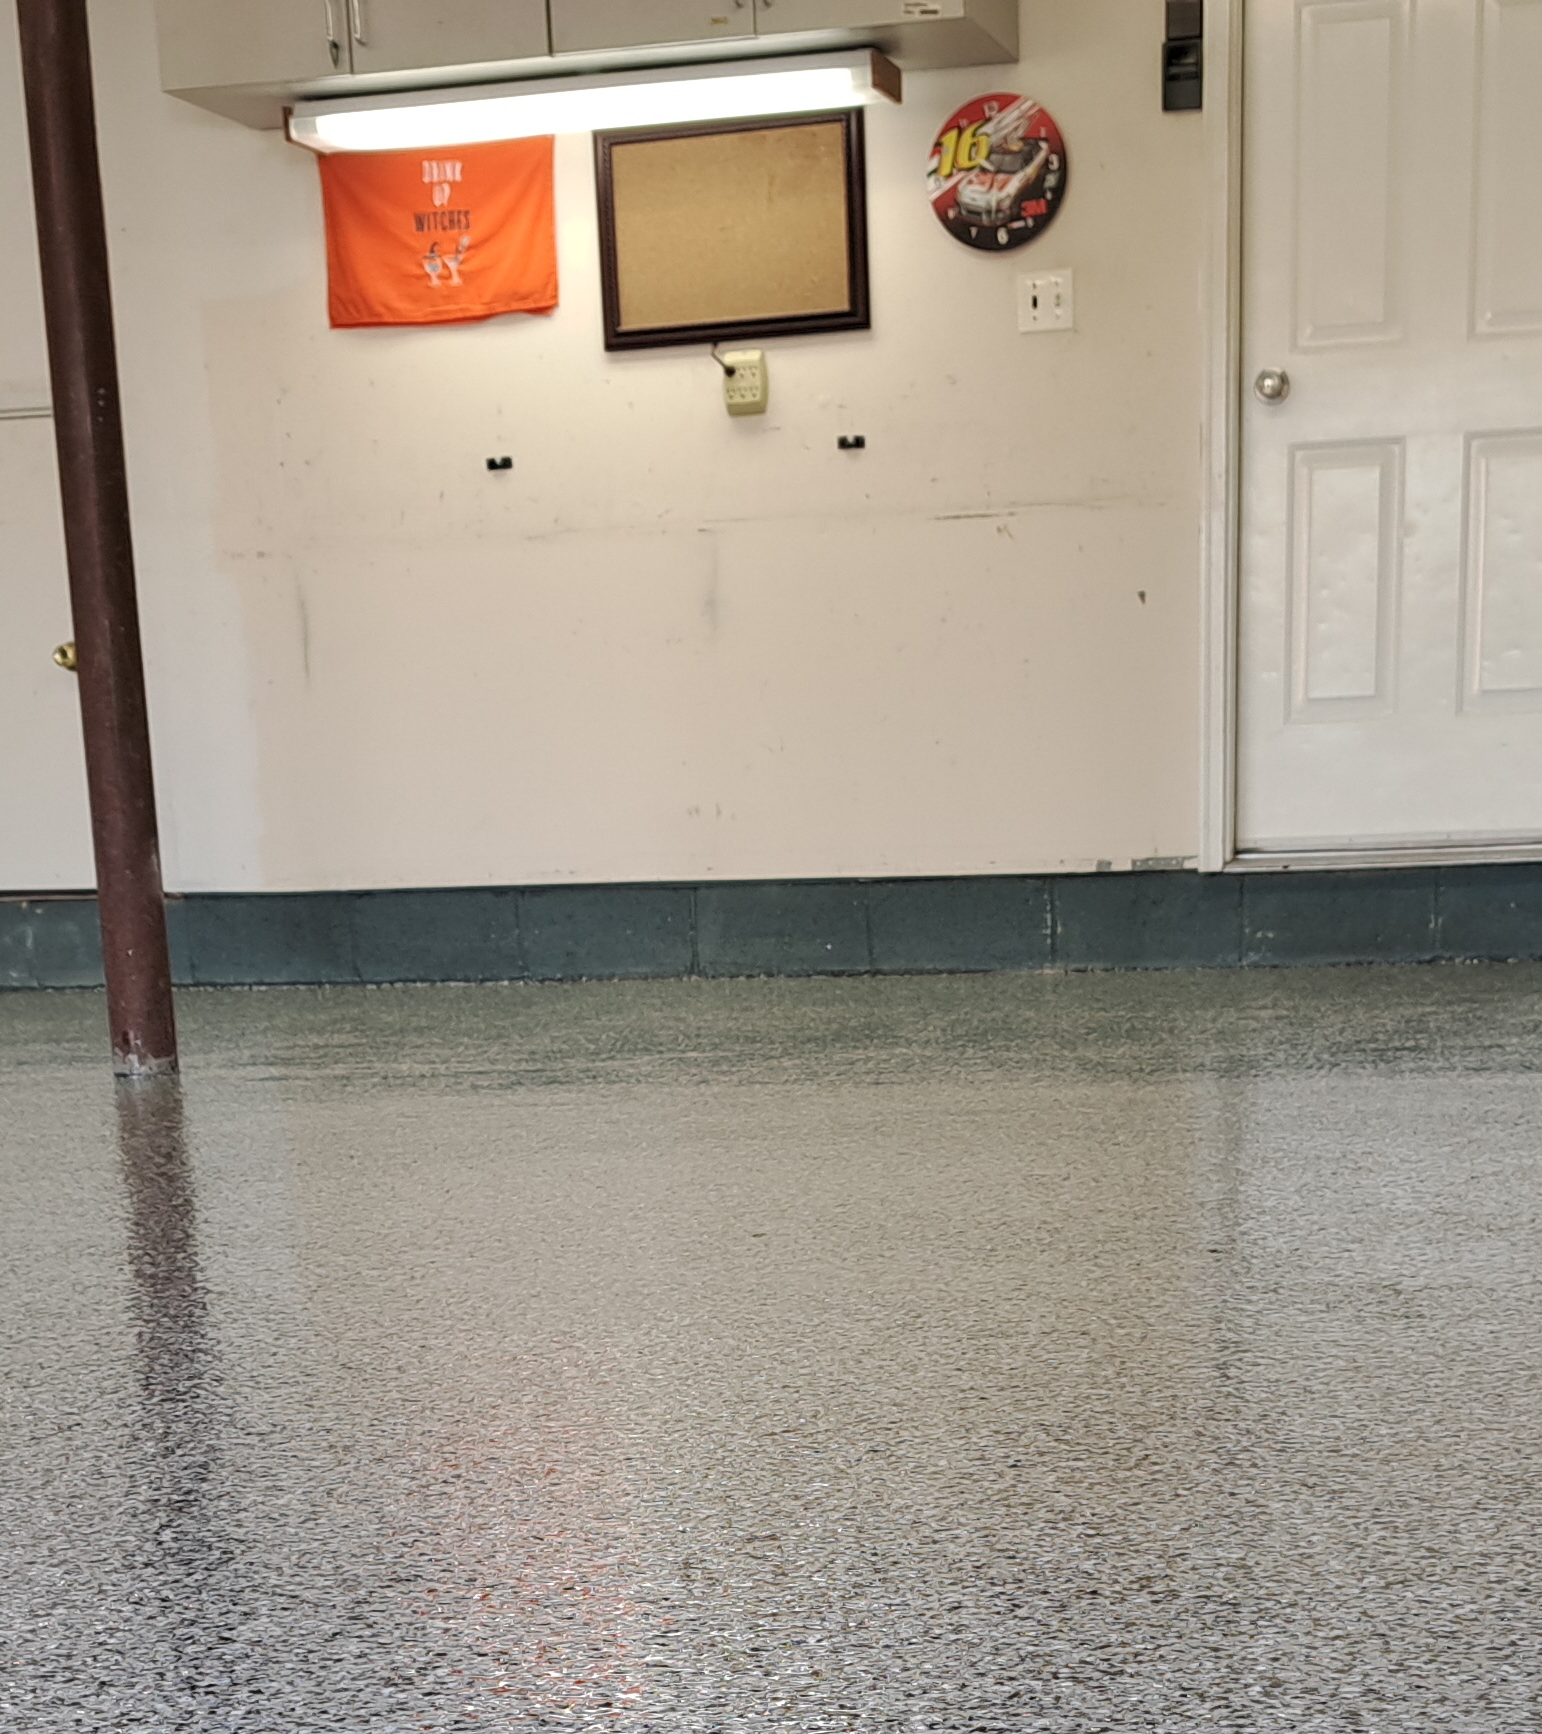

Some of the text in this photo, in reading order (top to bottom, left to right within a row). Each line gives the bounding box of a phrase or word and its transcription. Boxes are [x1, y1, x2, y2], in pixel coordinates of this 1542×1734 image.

[937, 120, 991, 178] 16
[432, 182, 451, 207] UP
[1021, 198, 1048, 217] 3M
[414, 209, 471, 232] WITCHES
